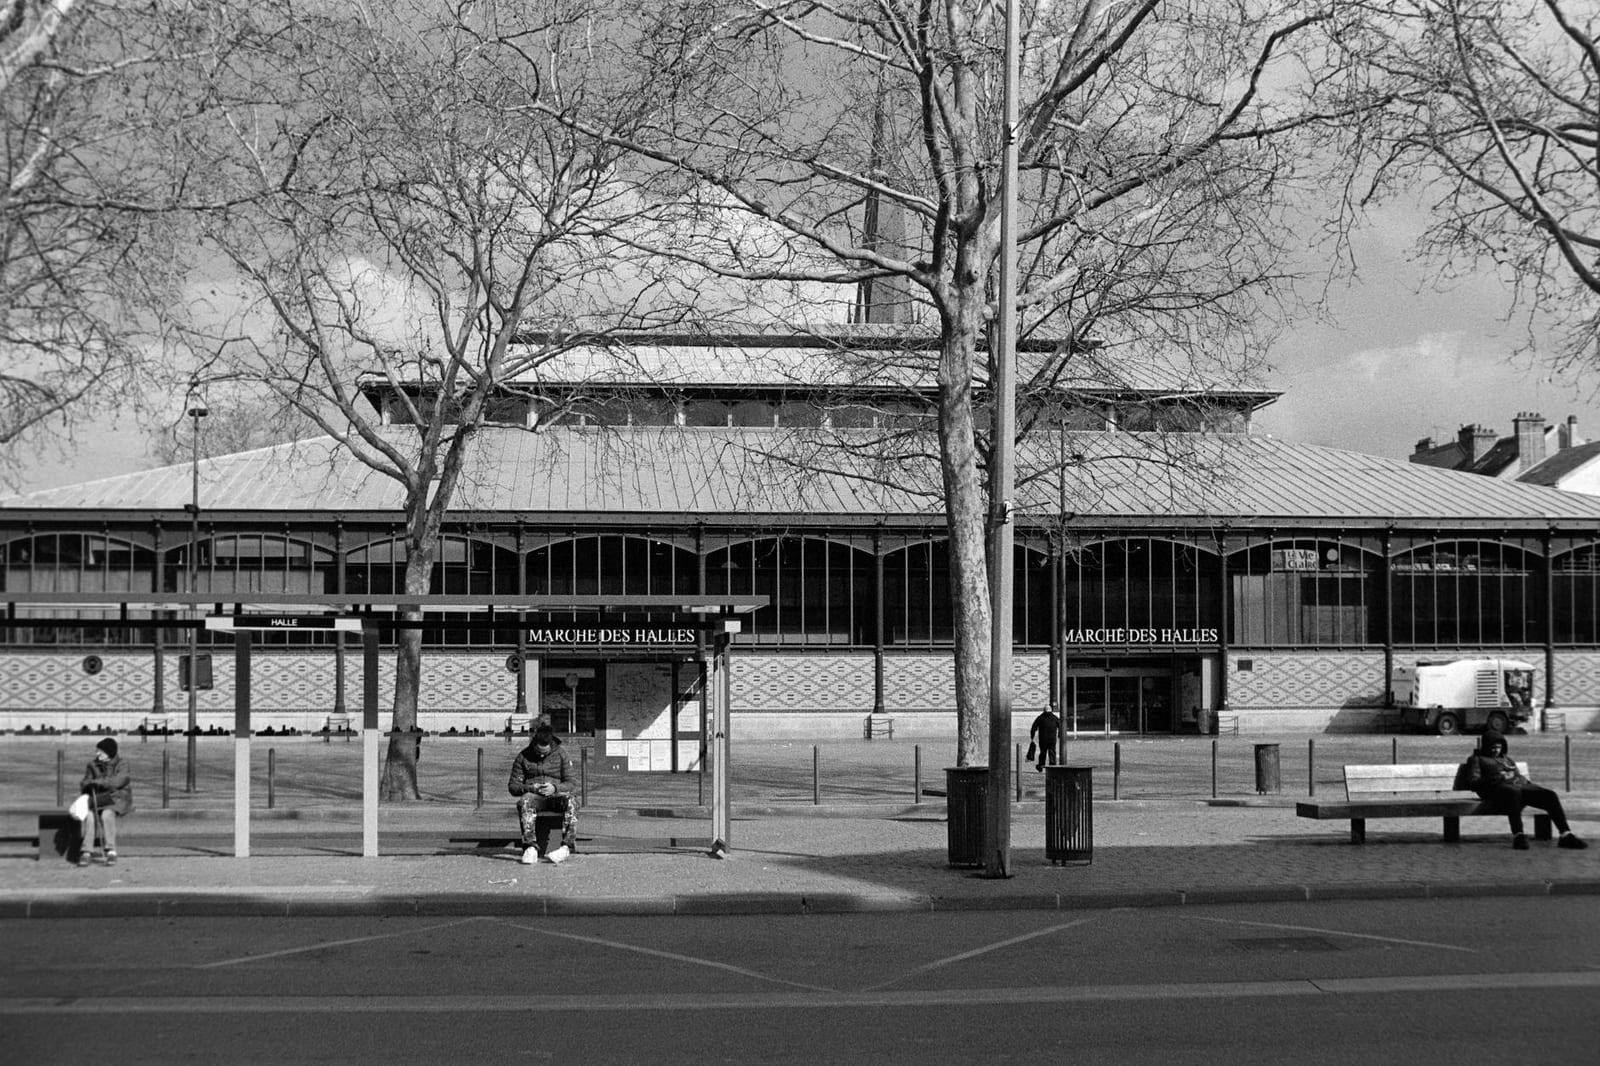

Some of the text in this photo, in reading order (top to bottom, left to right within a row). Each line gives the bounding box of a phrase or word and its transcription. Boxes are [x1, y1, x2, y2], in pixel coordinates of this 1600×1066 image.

[271, 618, 298, 627] HALLE
[601, 629, 631, 643] DES
[635, 629, 695, 643] HALLES
[1129, 629, 1158, 643] DES
[1161, 629, 1218, 643] HALLES
